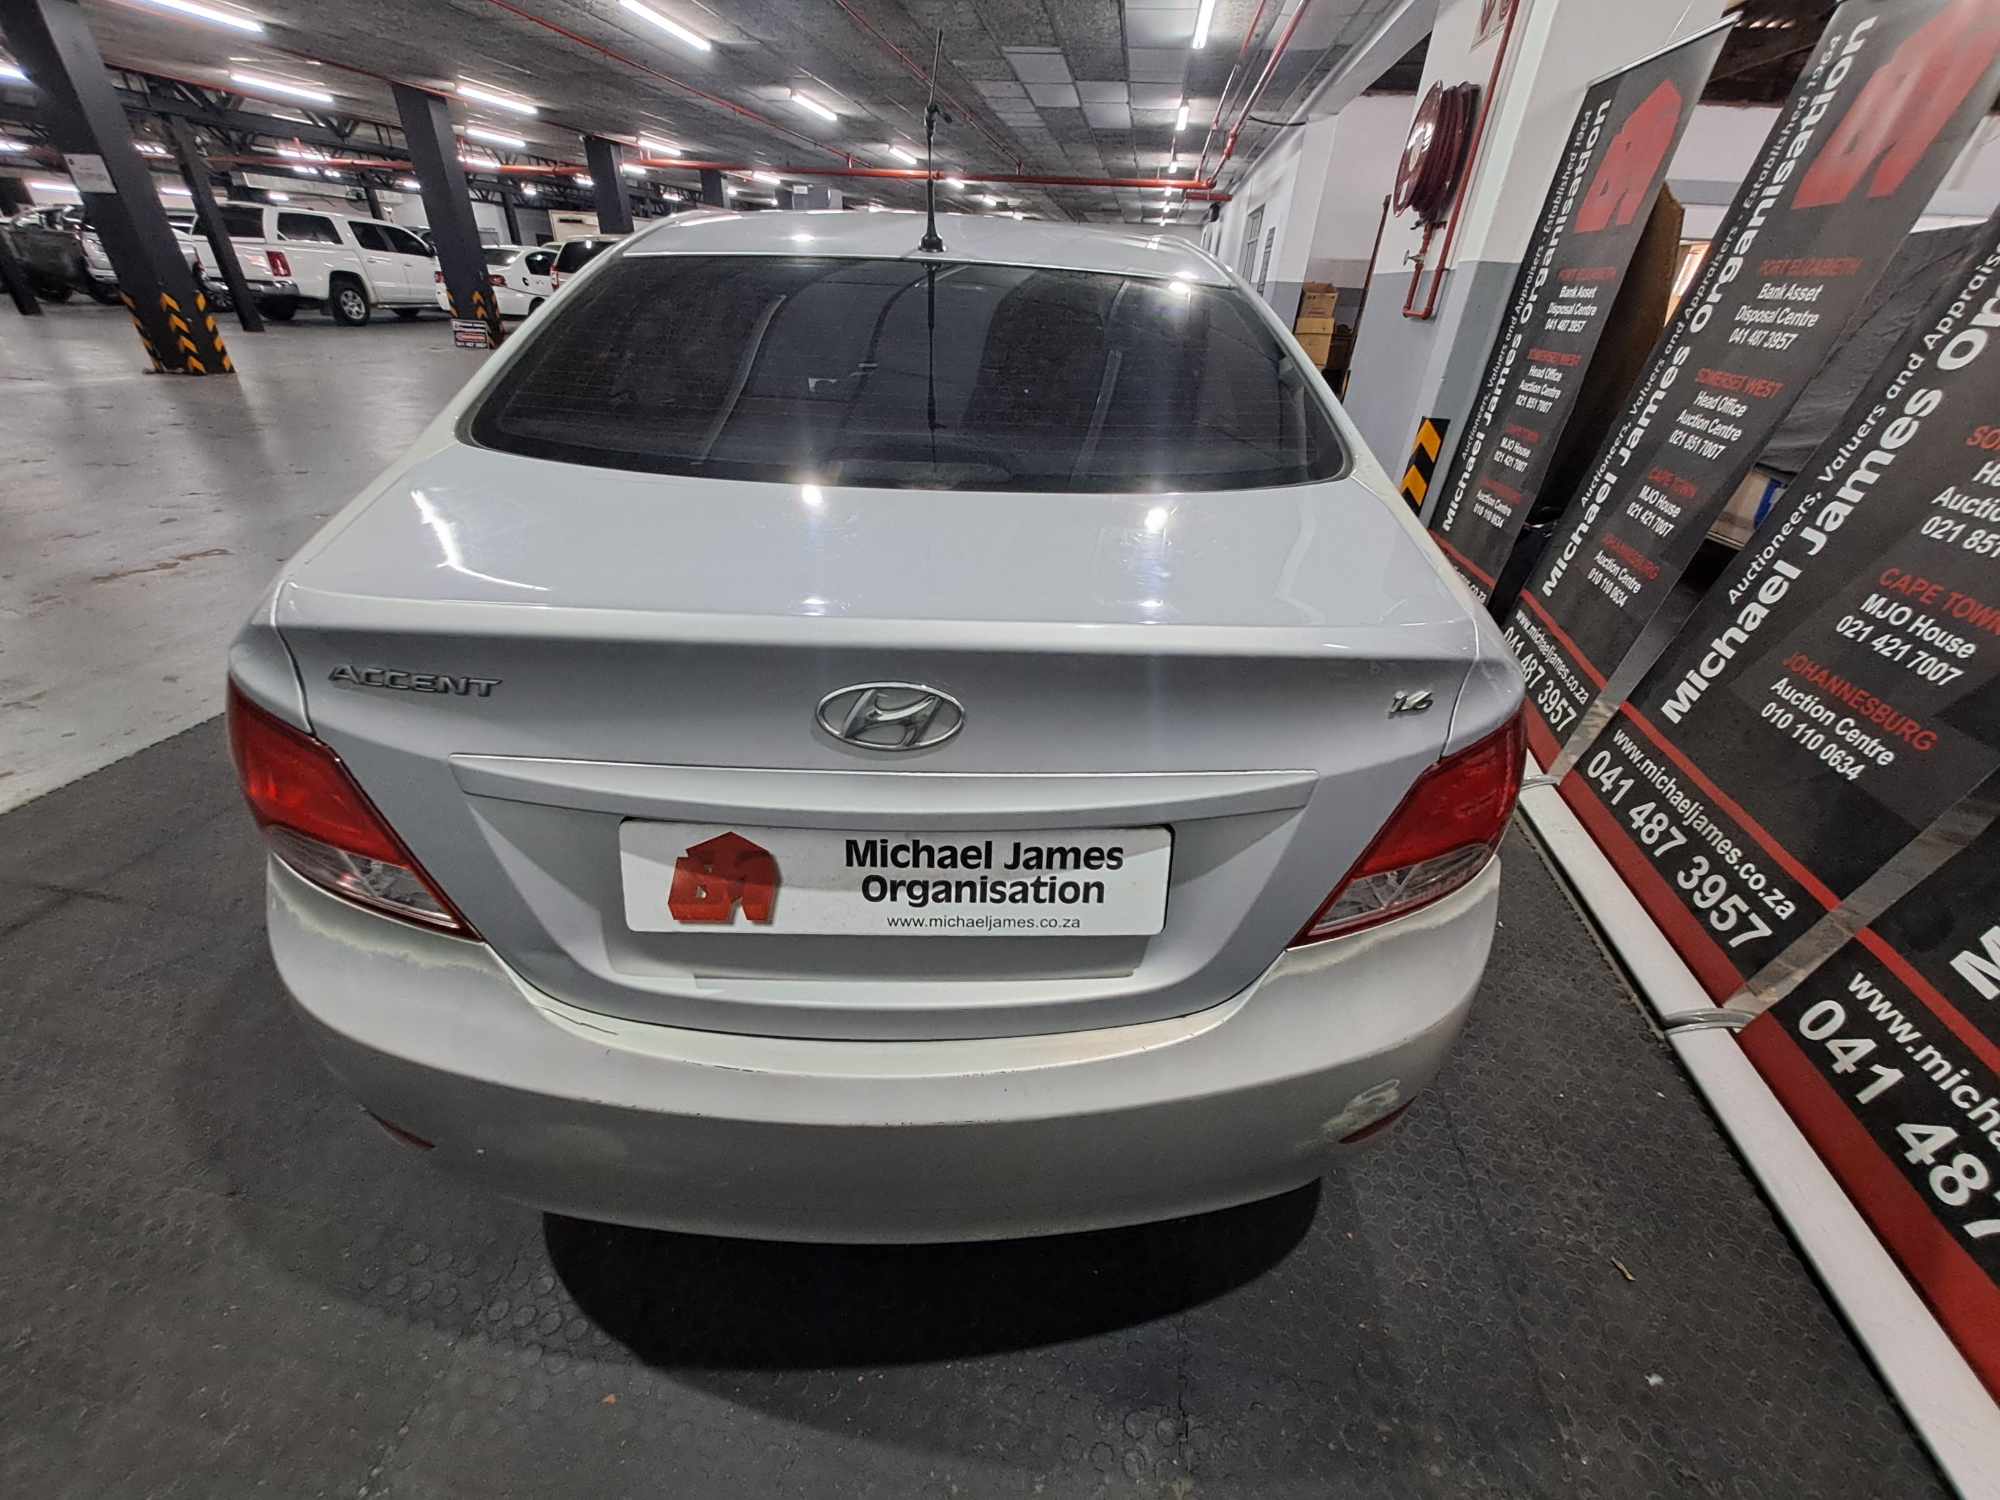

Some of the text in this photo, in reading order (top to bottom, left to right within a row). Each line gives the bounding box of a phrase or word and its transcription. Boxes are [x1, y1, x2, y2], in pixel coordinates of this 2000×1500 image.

[1628, 357, 1666, 415] Valuers
[1664, 321, 1685, 355] and
[1684, 226, 1738, 319] Appraisers
[1743, 95, 1808, 209] Established
[1805, 34, 1843, 90] 1964
[1442, 431, 1486, 532] Michael
[1485, 333, 1522, 426] James
[1520, 98, 1612, 324] Organisation
[1542, 471, 1618, 597] Michael
[1619, 345, 1690, 466] James
[1690, 16, 1880, 333] Organisation
[1734, 305, 1820, 327] Disposal Centre
[1757, 283, 1824, 302] Bank Asset
[1505, 316, 1517, 341] and
[1728, 328, 1751, 344] 041
[1763, 332, 1799, 350] 3957
[1676, 409, 1743, 442] Auction Centre
[1693, 391, 1748, 418] Head Office
[1728, 243, 2000, 605] Auctioneers, Valuers and Apprais
[1668, 429, 1688, 447] 021
[1698, 438, 1727, 460] 7007
[1656, 494, 1682, 518] House
[1920, 515, 1967, 543] 021
[1594, 550, 1621, 577] Auction
[1618, 567, 1642, 594] Centre
[1660, 559, 1802, 725] Michael
[1800, 388, 1943, 555] James
[1880, 567, 1945, 605] CAPE
[1836, 615, 1965, 686] 021 421 7007
[1860, 593, 1976, 659] MJO House
[328, 664, 503, 697] ACCENT
[1515, 609, 1590, 705] www.michaeljames.co.za
[1520, 652, 1546, 689] 487
[1537, 679, 1577, 732] 3957
[1783, 651, 1938, 751] JOHANNESBURG
[1760, 702, 1865, 781] 010 110 0634
[1771, 677, 1895, 767] Auction Centre
[1587, 749, 1773, 949] 041 487 3957
[1613, 727, 1797, 921] www.michaeljames.co.za
[845, 839, 1124, 871] Michael James
[861, 875, 1105, 907] Organisation
[887, 914, 1081, 931] www.michaeljames.co.za
[1798, 999, 1905, 1105] 041
